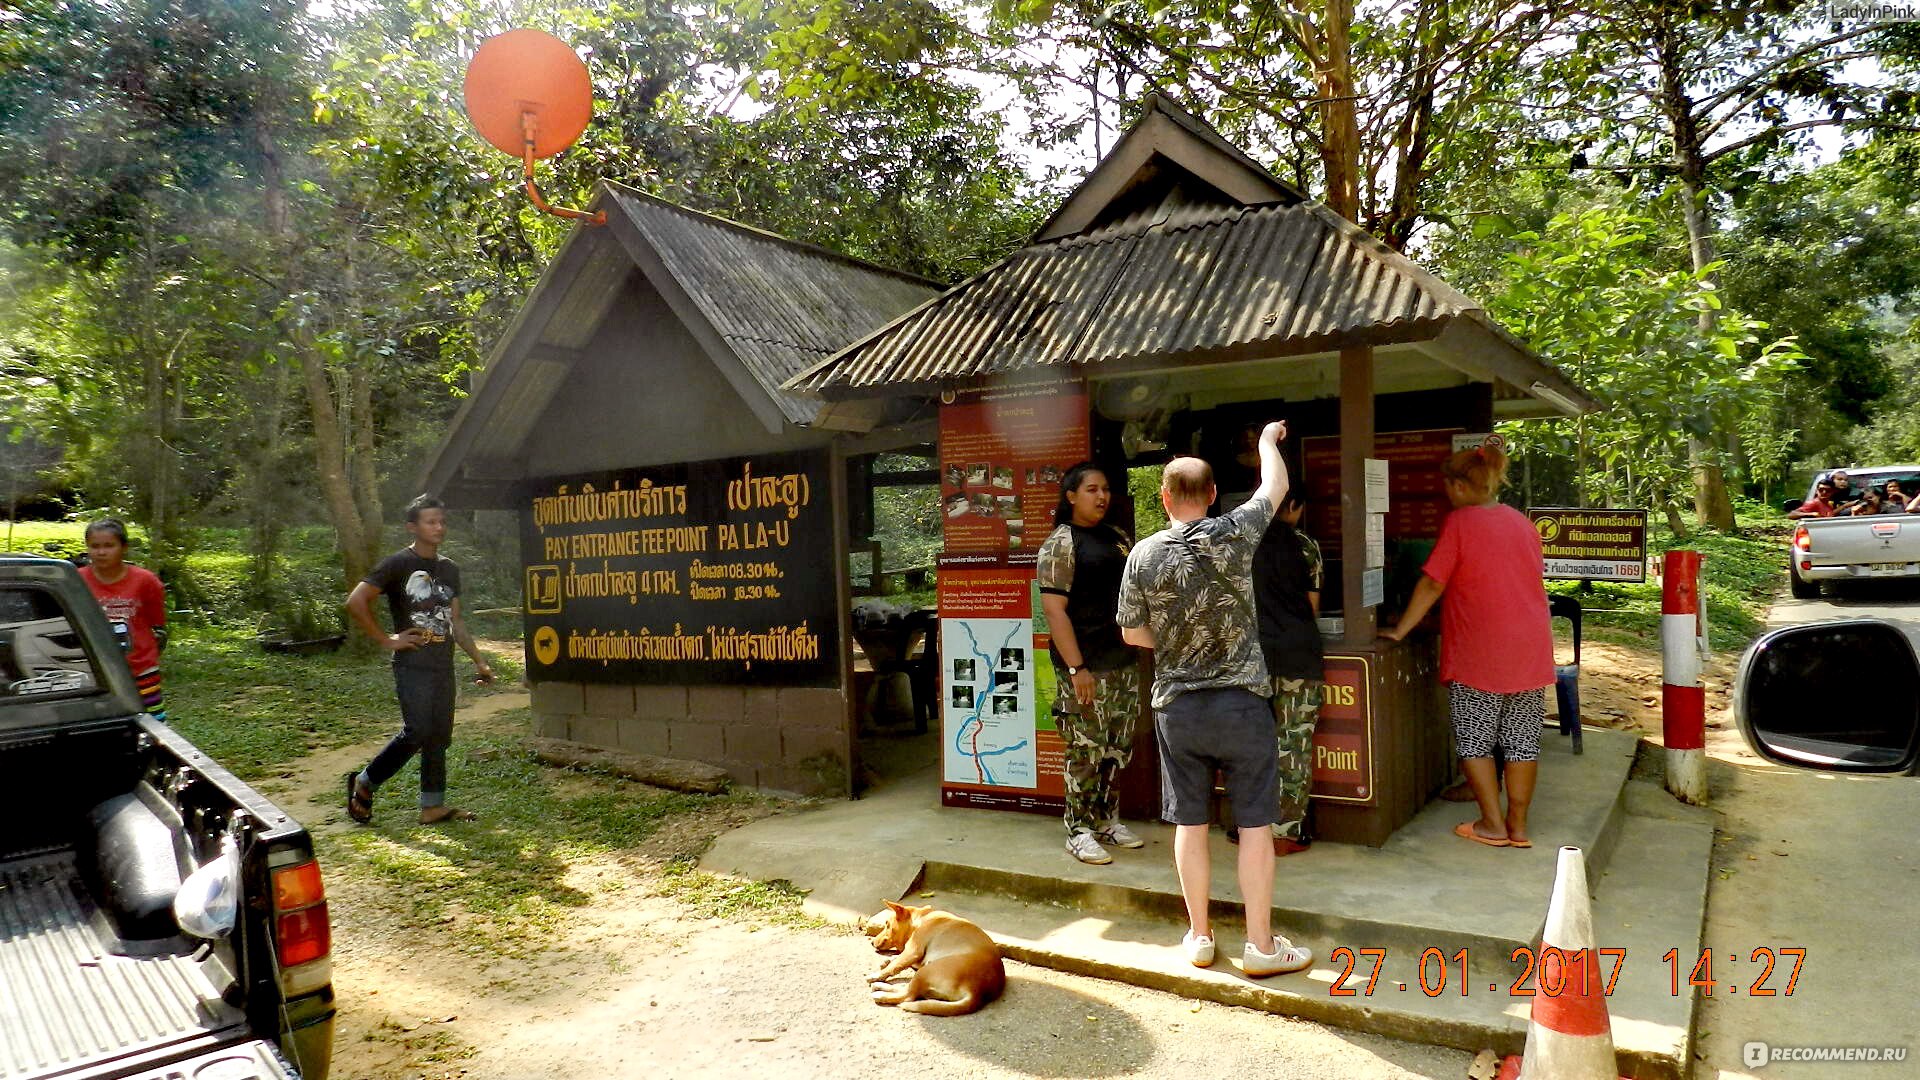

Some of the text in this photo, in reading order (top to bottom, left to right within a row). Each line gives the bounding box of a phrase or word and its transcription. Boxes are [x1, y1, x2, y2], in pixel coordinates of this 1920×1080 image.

[532, 461, 810, 534] จุดเก็บเงินค่าบริการ (ป่าละอู)
[545, 535, 569, 561] PAY
[572, 530, 640, 559] ENTRANCE
[641, 529, 664, 554] FEE
[666, 525, 709, 554] POINT
[719, 523, 739, 551] PA
[565, 559, 637, 605] น้ำตกป่าละอู
[1615, 564, 1641, 577] 1669
[1317, 745, 1358, 771] Point
